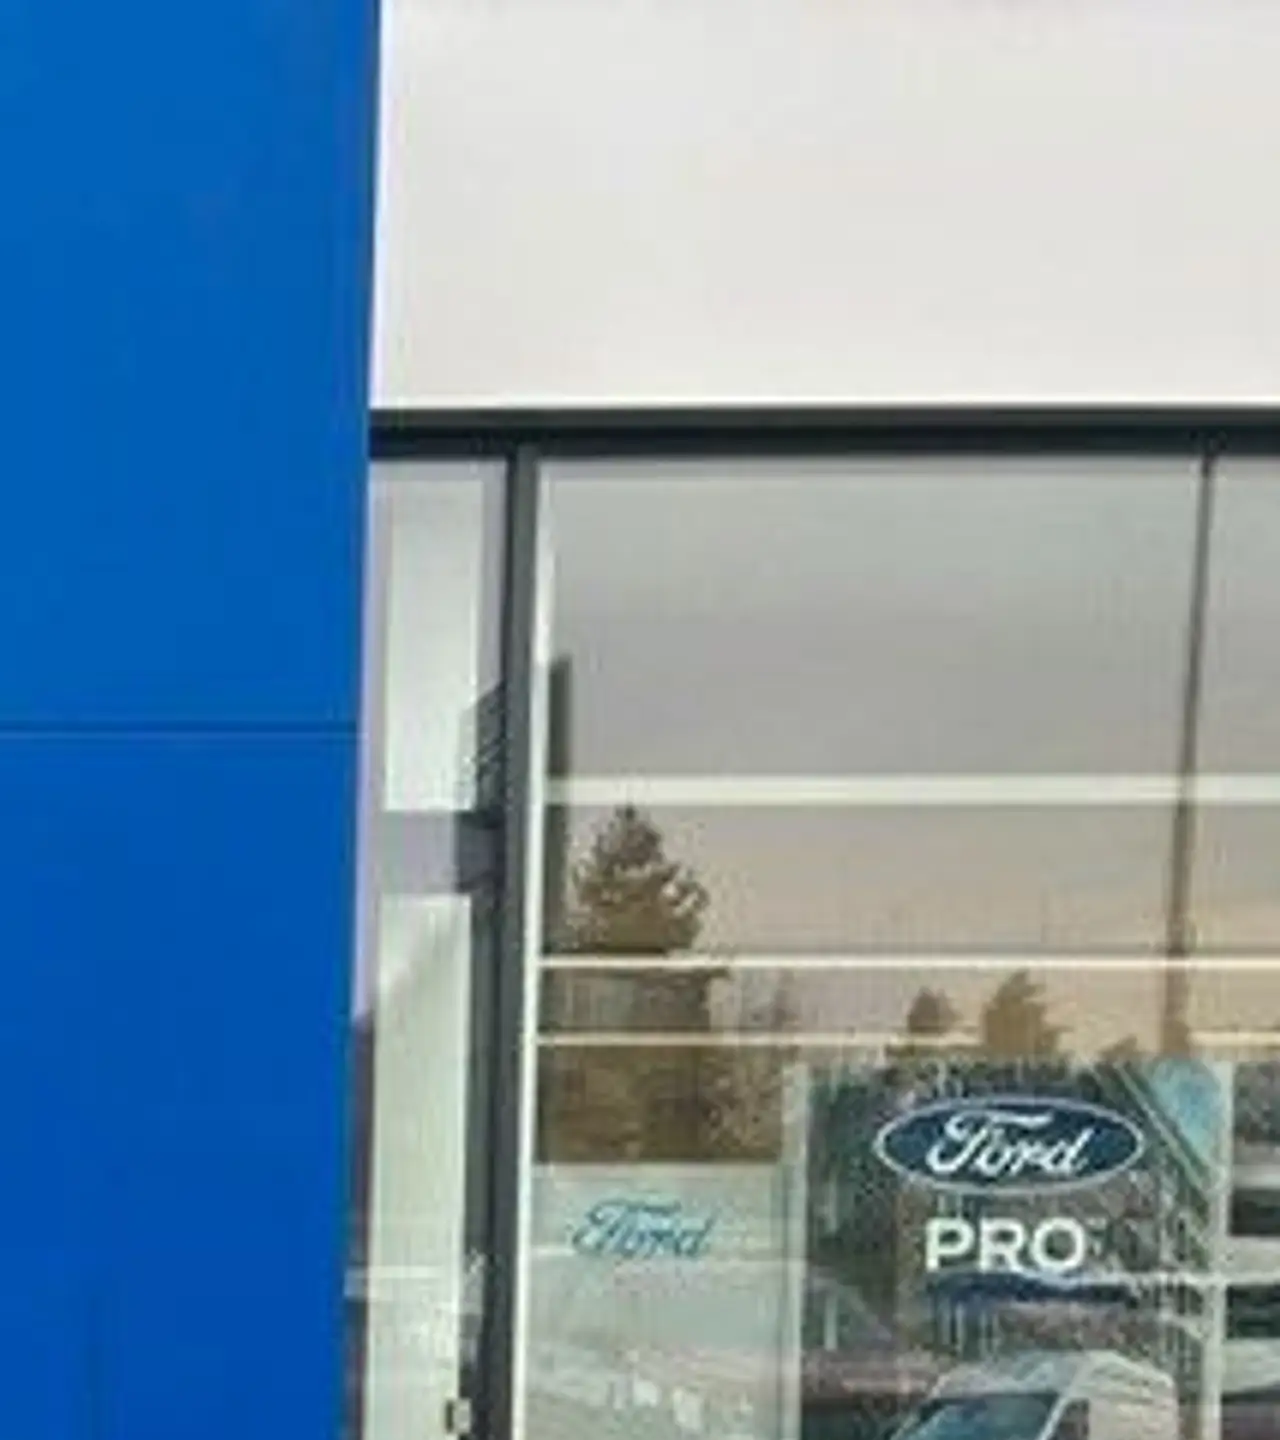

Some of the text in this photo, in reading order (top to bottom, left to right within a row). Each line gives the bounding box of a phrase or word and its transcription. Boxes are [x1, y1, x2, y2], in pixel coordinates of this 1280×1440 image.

[926, 1107, 1091, 1176] Ford
[571, 1199, 716, 1260] Ford
[925, 1217, 1086, 1272] PRO
